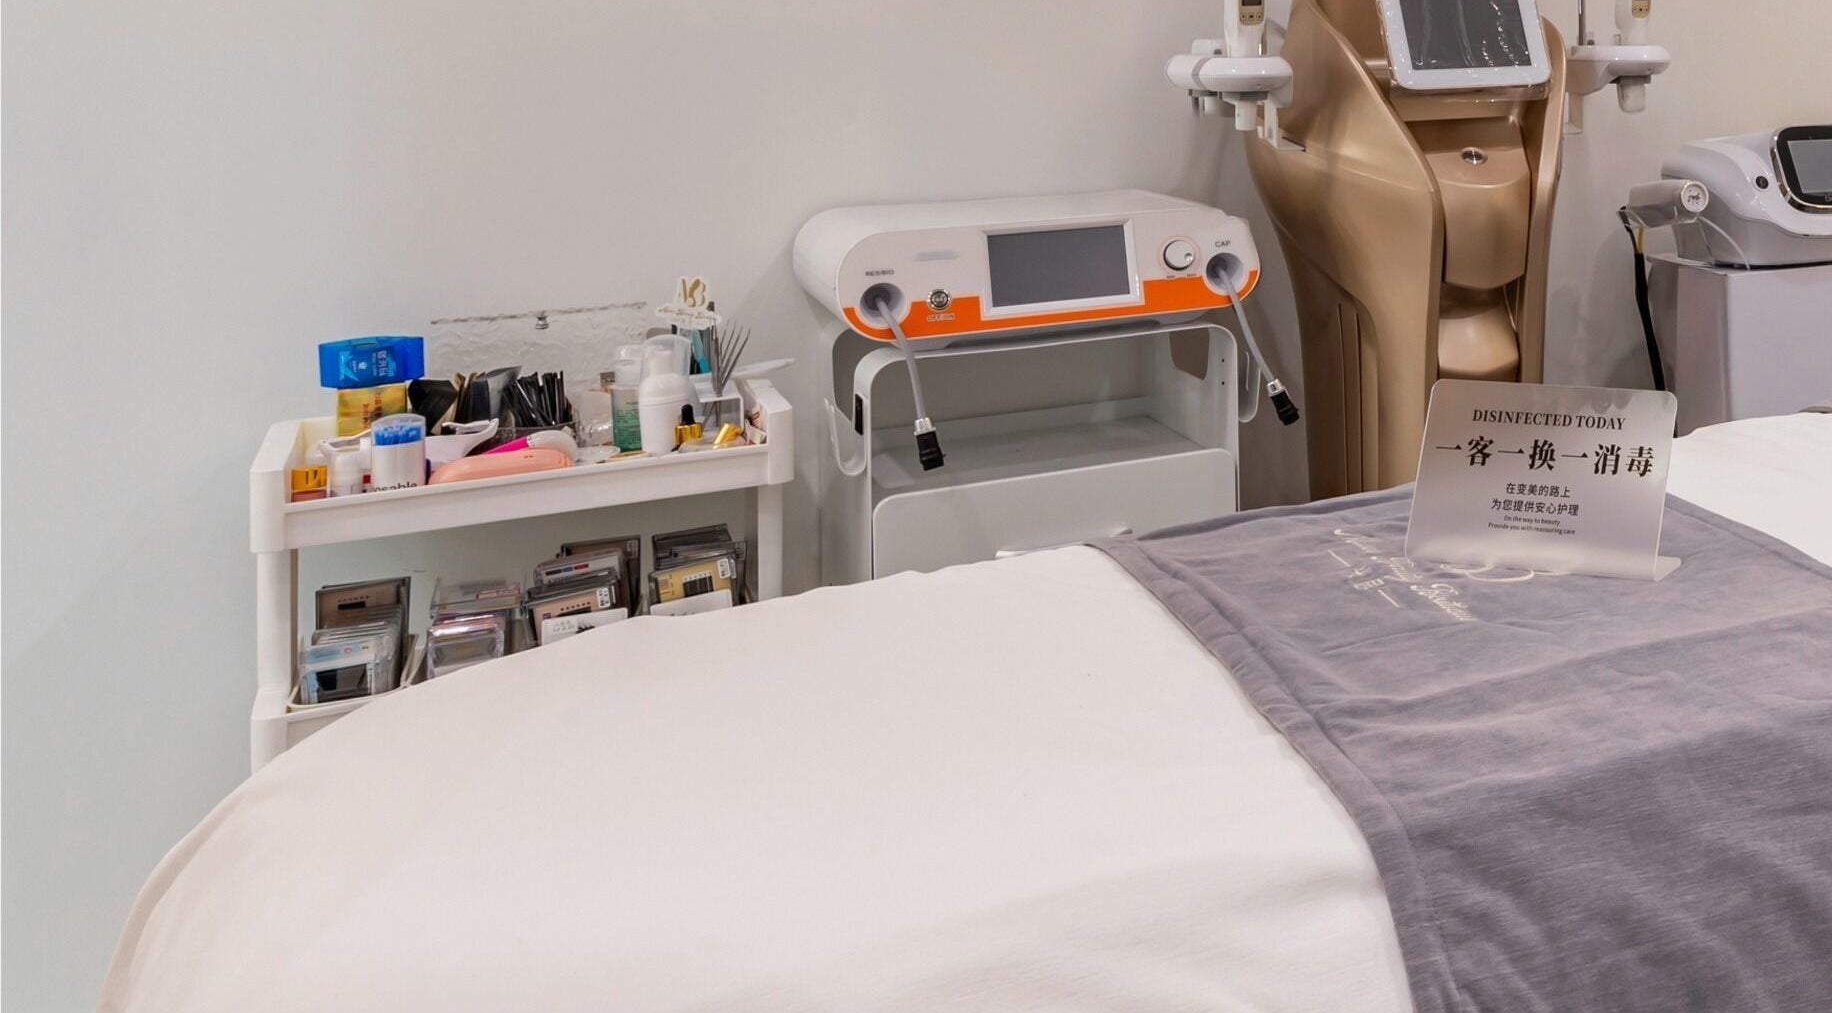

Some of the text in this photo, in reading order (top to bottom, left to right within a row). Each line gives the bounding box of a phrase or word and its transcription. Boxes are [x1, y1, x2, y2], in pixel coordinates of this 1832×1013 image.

[1472, 409, 1626, 430] DISINFECTED TODAY
[1435, 435, 1654, 477] 一客一换一消毒
[1505, 482, 1571, 498] 在变美的路上
[1491, 498, 1580, 516] 为您提供安心护理
